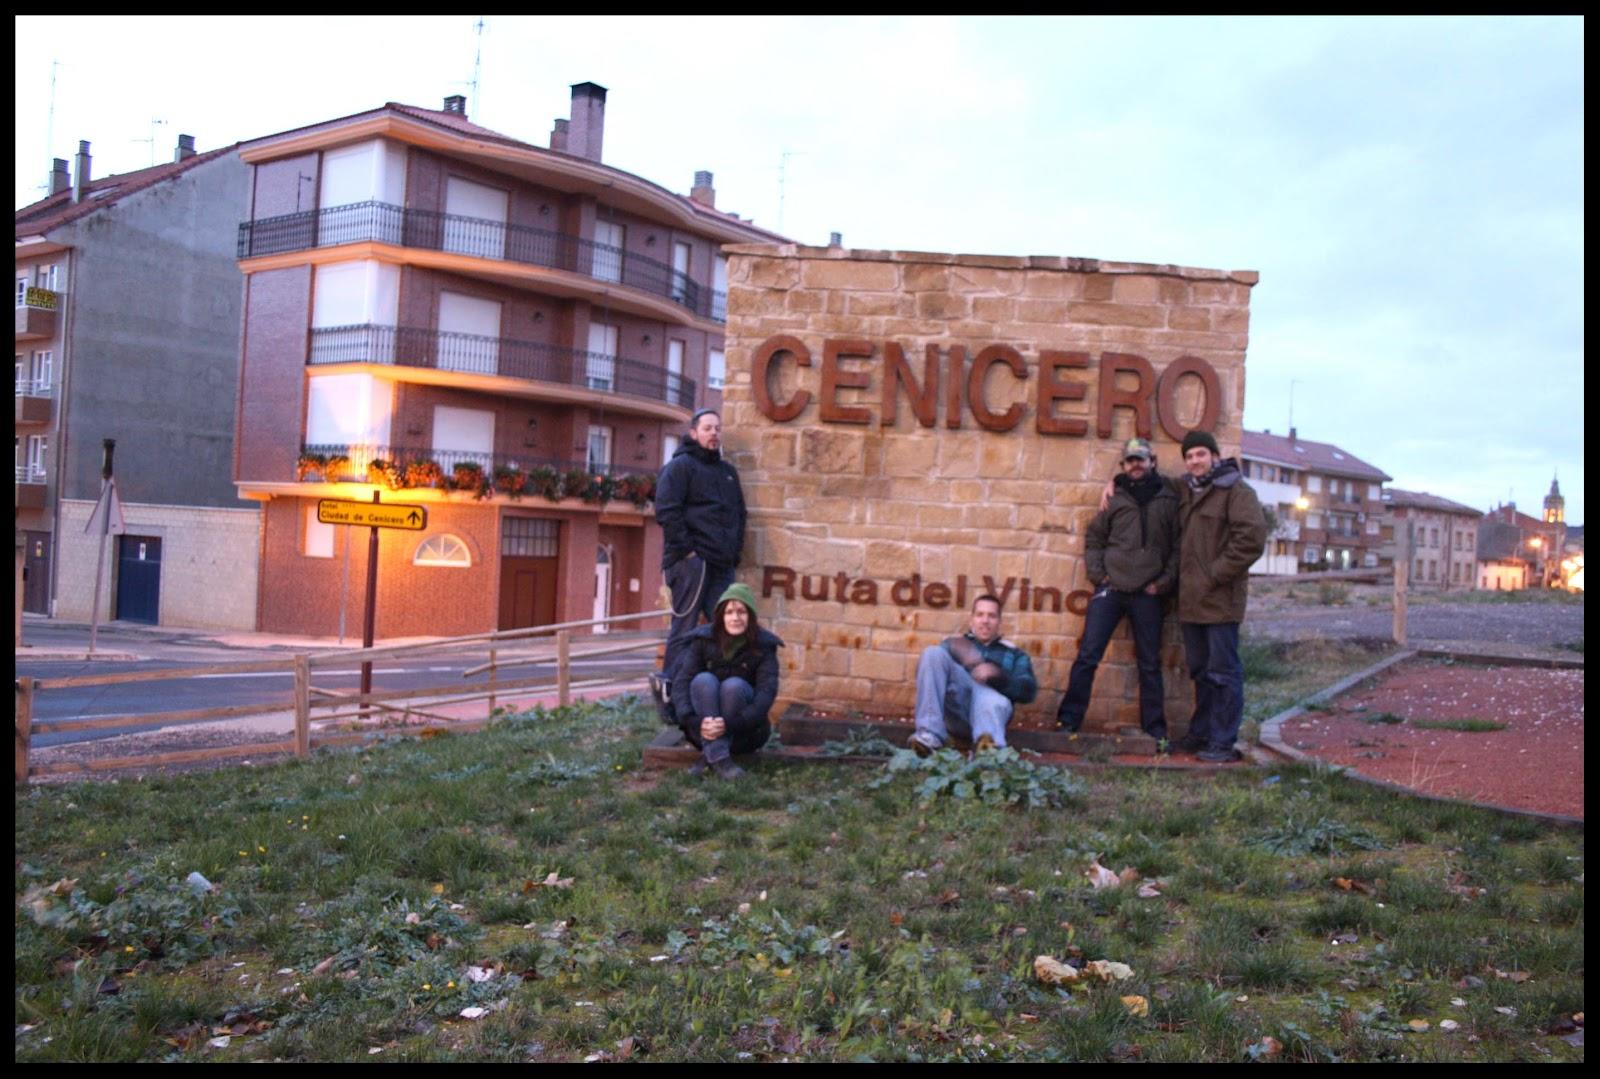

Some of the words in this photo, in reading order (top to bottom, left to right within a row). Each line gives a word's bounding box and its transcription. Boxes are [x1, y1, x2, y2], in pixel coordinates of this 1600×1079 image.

[750, 334, 1221, 443] CENICERO
[321, 510, 350, 521] Ciudad
[353, 513, 363, 521] de
[368, 513, 404, 525] Cenicero
[761, 565, 879, 606] Ruta
[890, 573, 967, 609] del
[982, 575, 1090, 616] Vino
